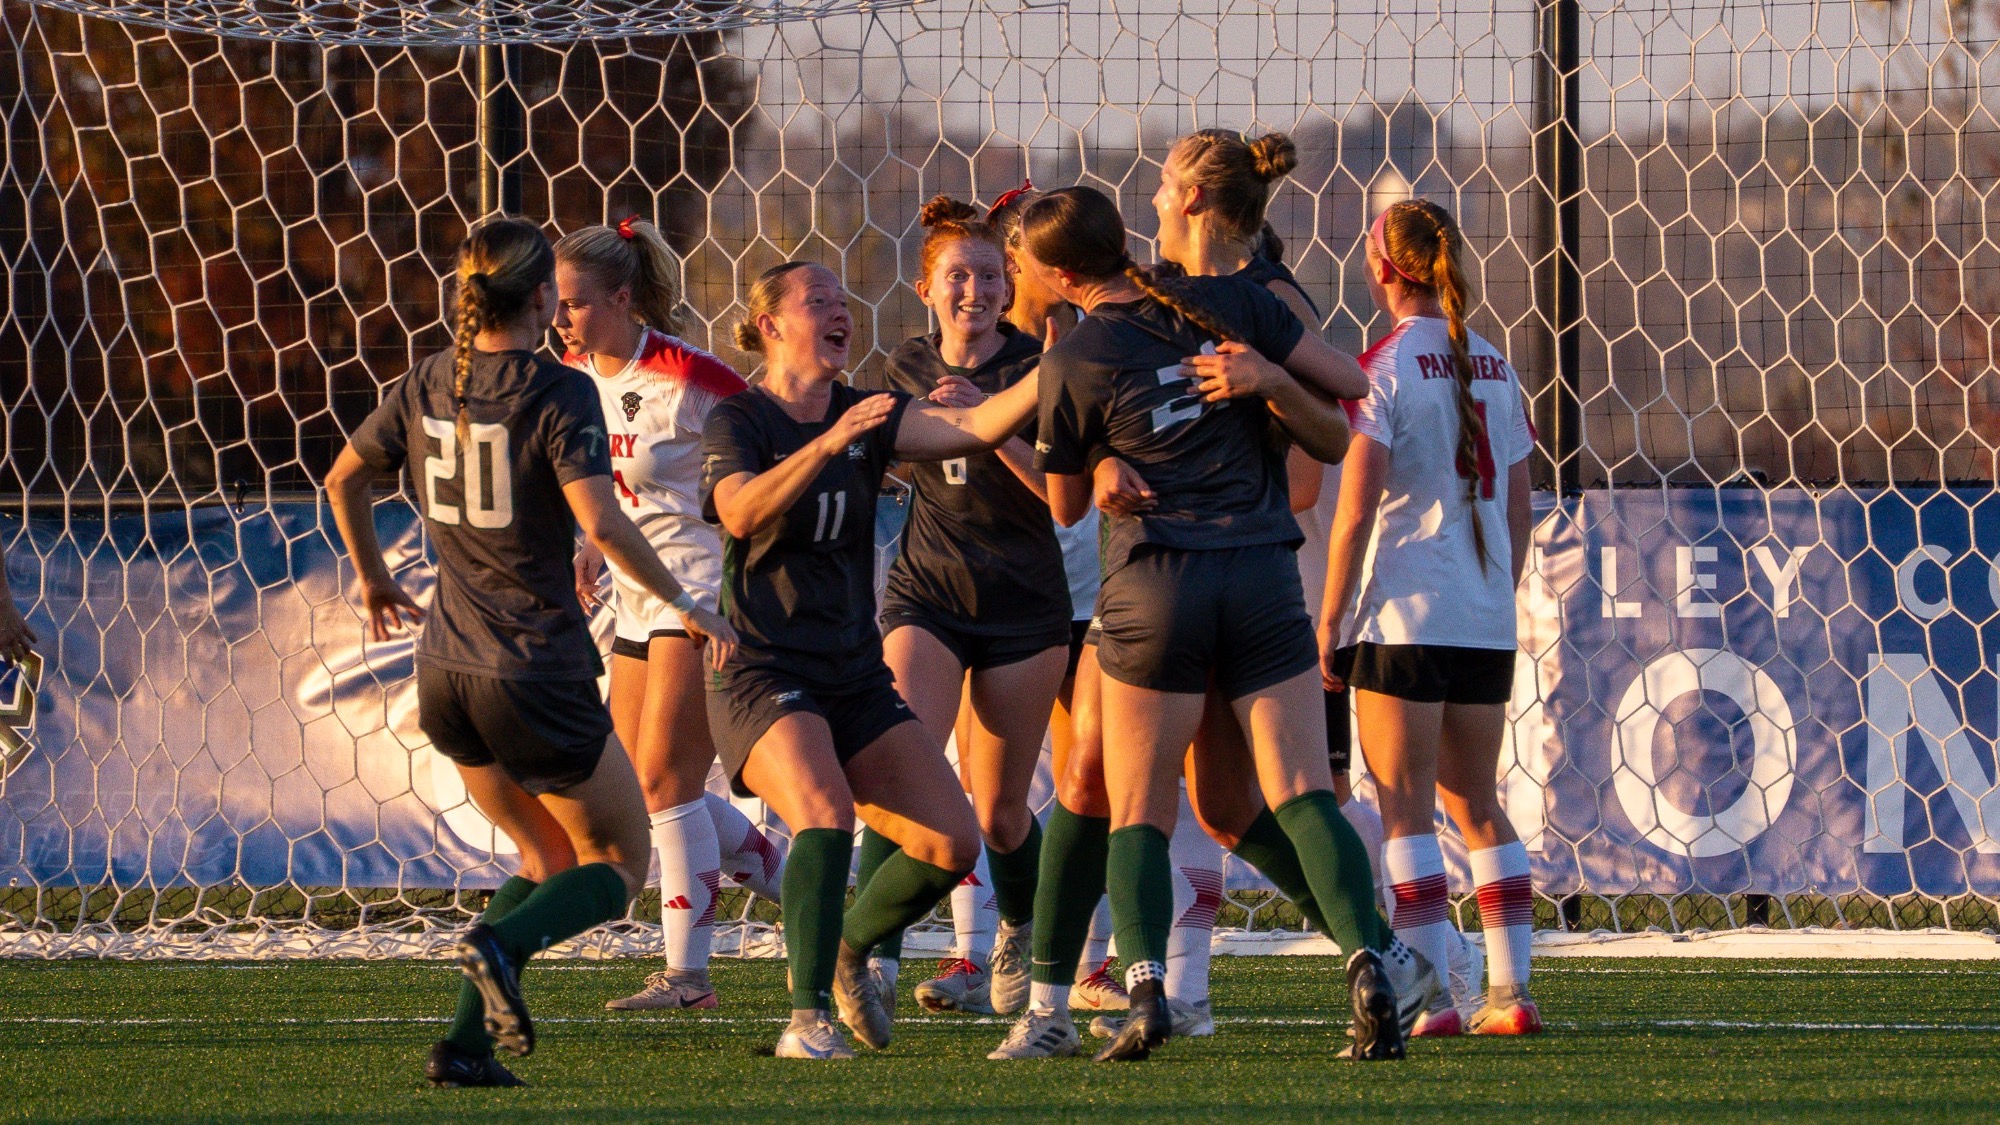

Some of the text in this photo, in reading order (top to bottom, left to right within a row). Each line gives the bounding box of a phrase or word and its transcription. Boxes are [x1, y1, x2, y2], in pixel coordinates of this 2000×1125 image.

[1415, 353, 1507, 382] PANERS
[422, 416, 513, 528] 20
[814, 491, 846, 542] 11
